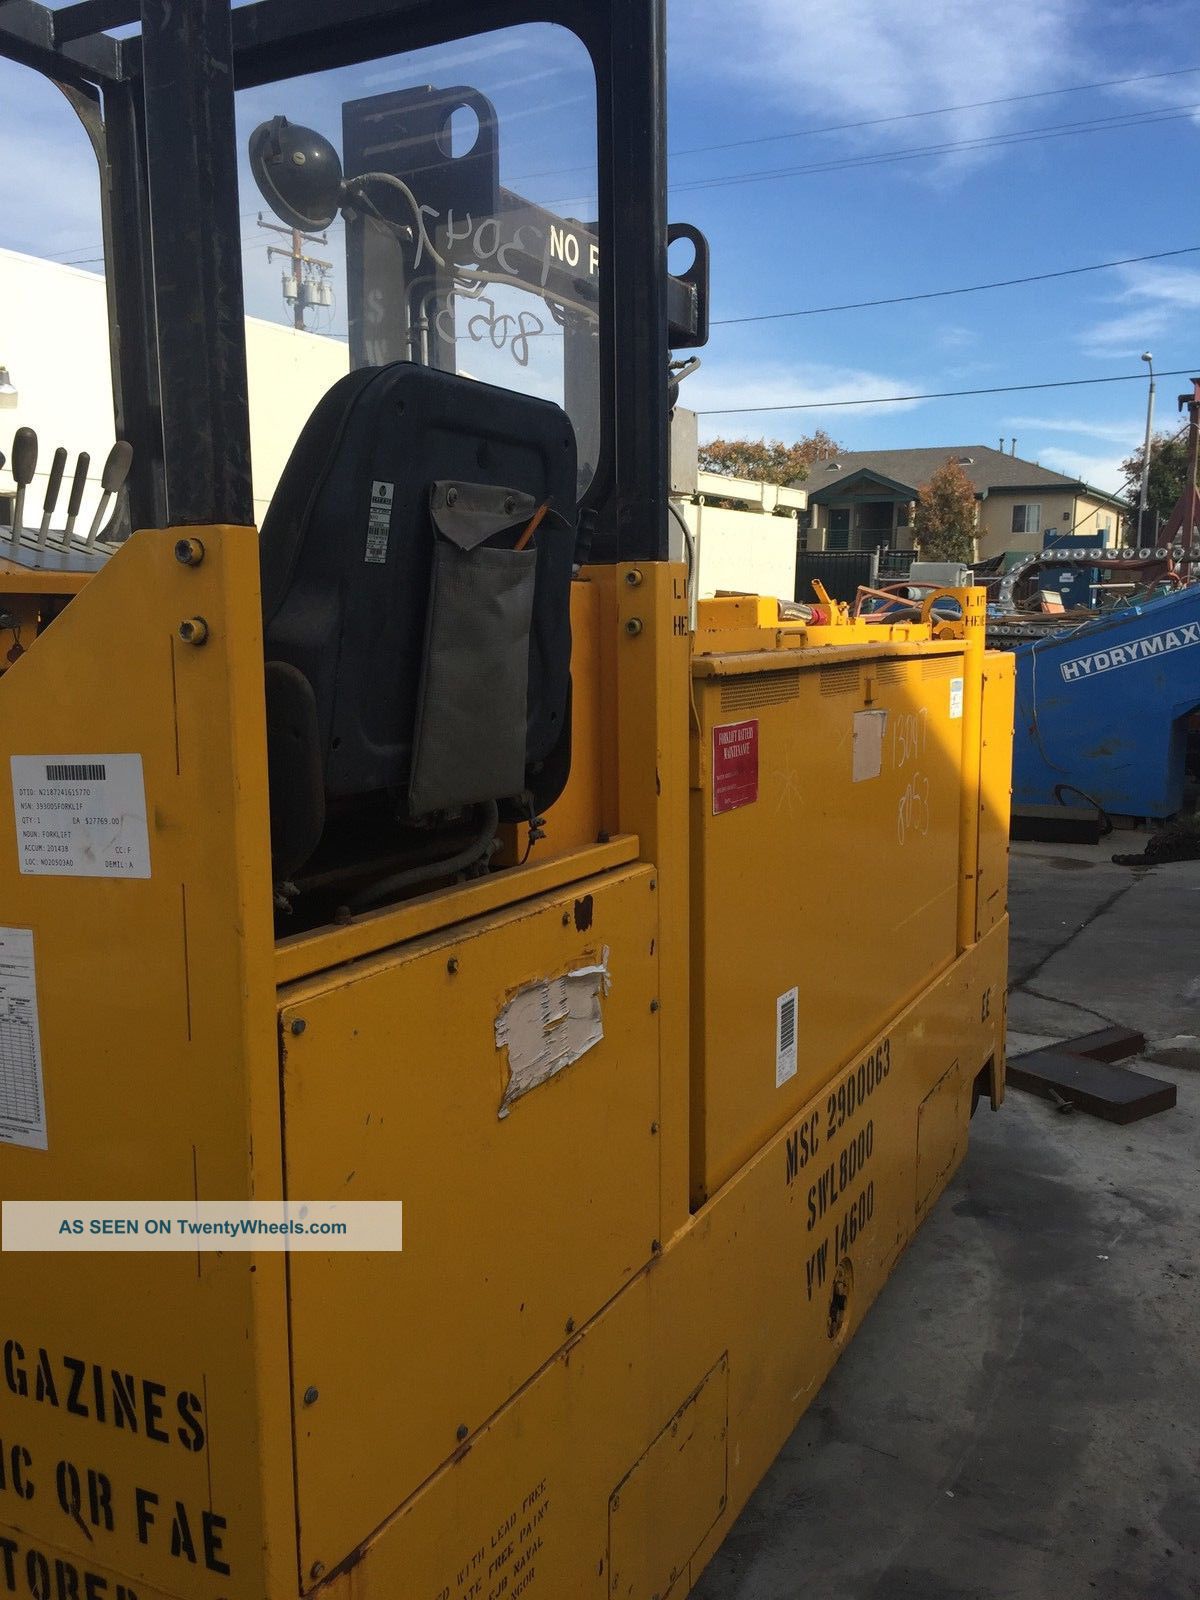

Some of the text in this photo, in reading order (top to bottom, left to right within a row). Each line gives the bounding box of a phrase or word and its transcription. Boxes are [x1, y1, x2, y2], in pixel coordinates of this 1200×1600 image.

[550, 225, 579, 267] NO
[1062, 624, 1200, 680] HYDRYMAX
[786, 1038, 891, 1185] MSC 2900063
[835, 1180, 874, 1266] 14600
[4, 1339, 205, 1452] GAZINES
[135, 1487, 231, 1576] FAE
[457, 1547, 485, 1586] WITH
[490, 1512, 517, 1549] LEAD
[522, 1478, 547, 1514] FREE
[488, 1542, 514, 1580] FREE
[519, 1500, 550, 1543] PAINT
[513, 1536, 543, 1577] NAVAL
